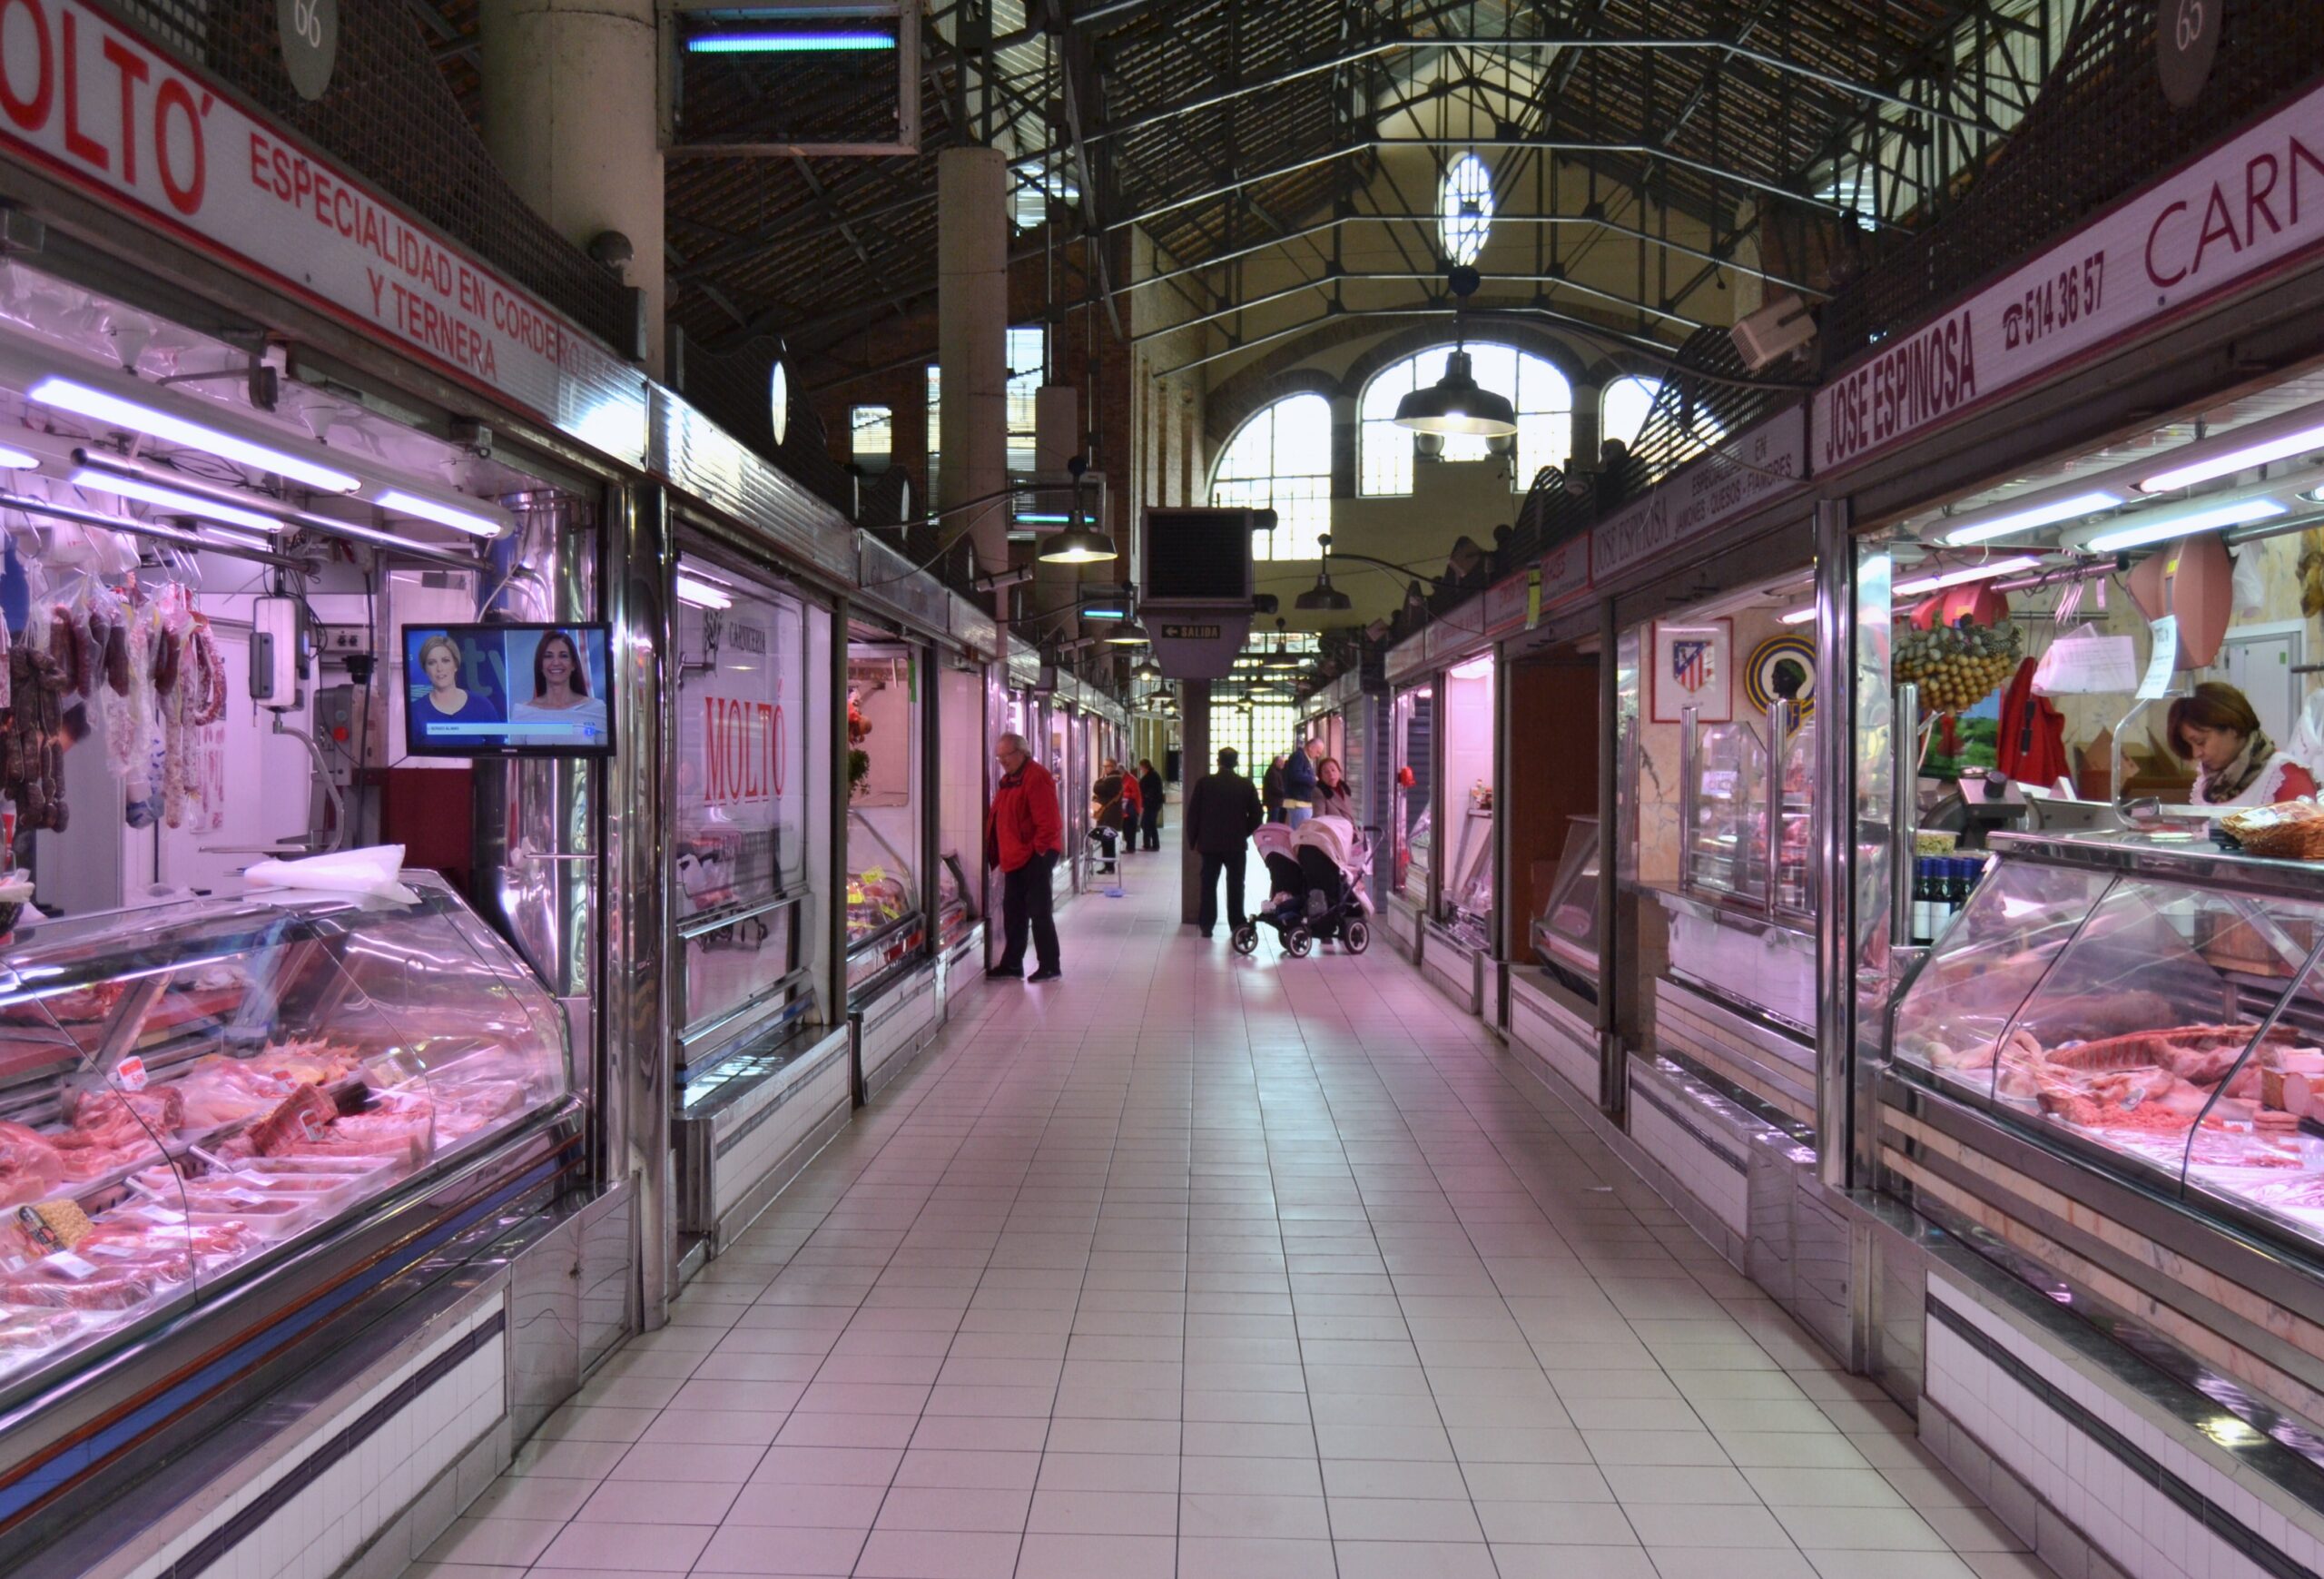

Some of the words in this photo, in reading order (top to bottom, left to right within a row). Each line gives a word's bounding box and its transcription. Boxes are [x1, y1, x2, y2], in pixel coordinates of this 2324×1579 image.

[294, 0, 322, 49] 66
[249, 132, 453, 298] ESPECIALIDAD
[458, 258, 487, 321] EN
[492, 288, 580, 377] CORDERO
[2024, 281, 2054, 346] 514
[2057, 265, 2079, 329] 36
[2083, 250, 2105, 318] 57
[368, 267, 384, 317] Y
[391, 281, 498, 383] TERNERA
[1825, 368, 1869, 465] JOSE
[1873, 310, 1976, 440] ESPINOSA
[1710, 478, 1741, 516] QUESOS
[1181, 627, 1218, 638] SALIDA
[704, 678, 786, 804] MOLTÓ
